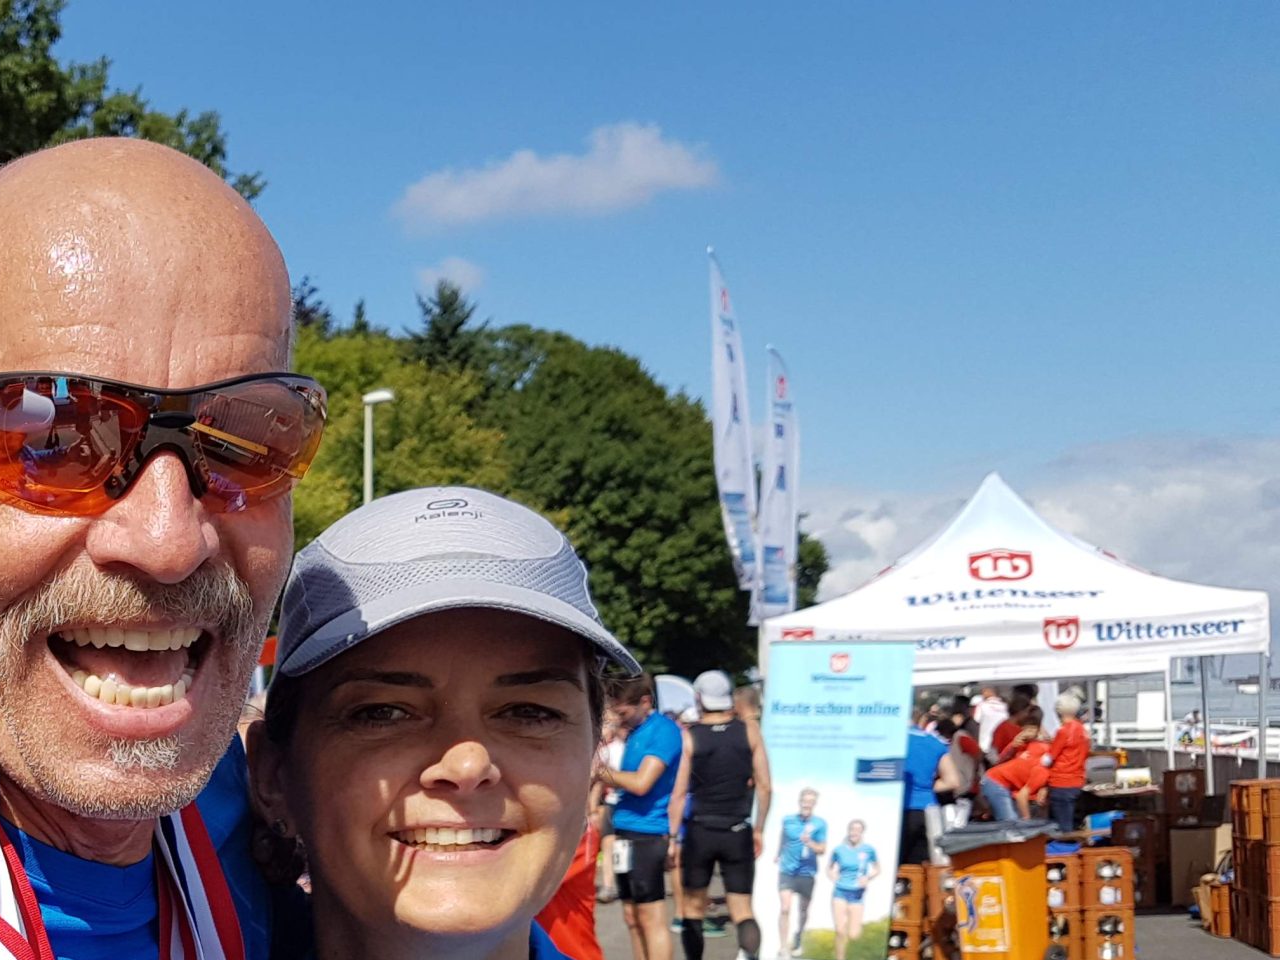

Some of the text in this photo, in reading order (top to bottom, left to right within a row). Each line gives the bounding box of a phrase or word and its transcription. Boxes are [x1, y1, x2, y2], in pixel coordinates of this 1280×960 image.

[414, 509, 484, 523] Kalenji
[904, 587, 1105, 608] Wittenseer
[1092, 618, 1246, 643] Wittenseer
